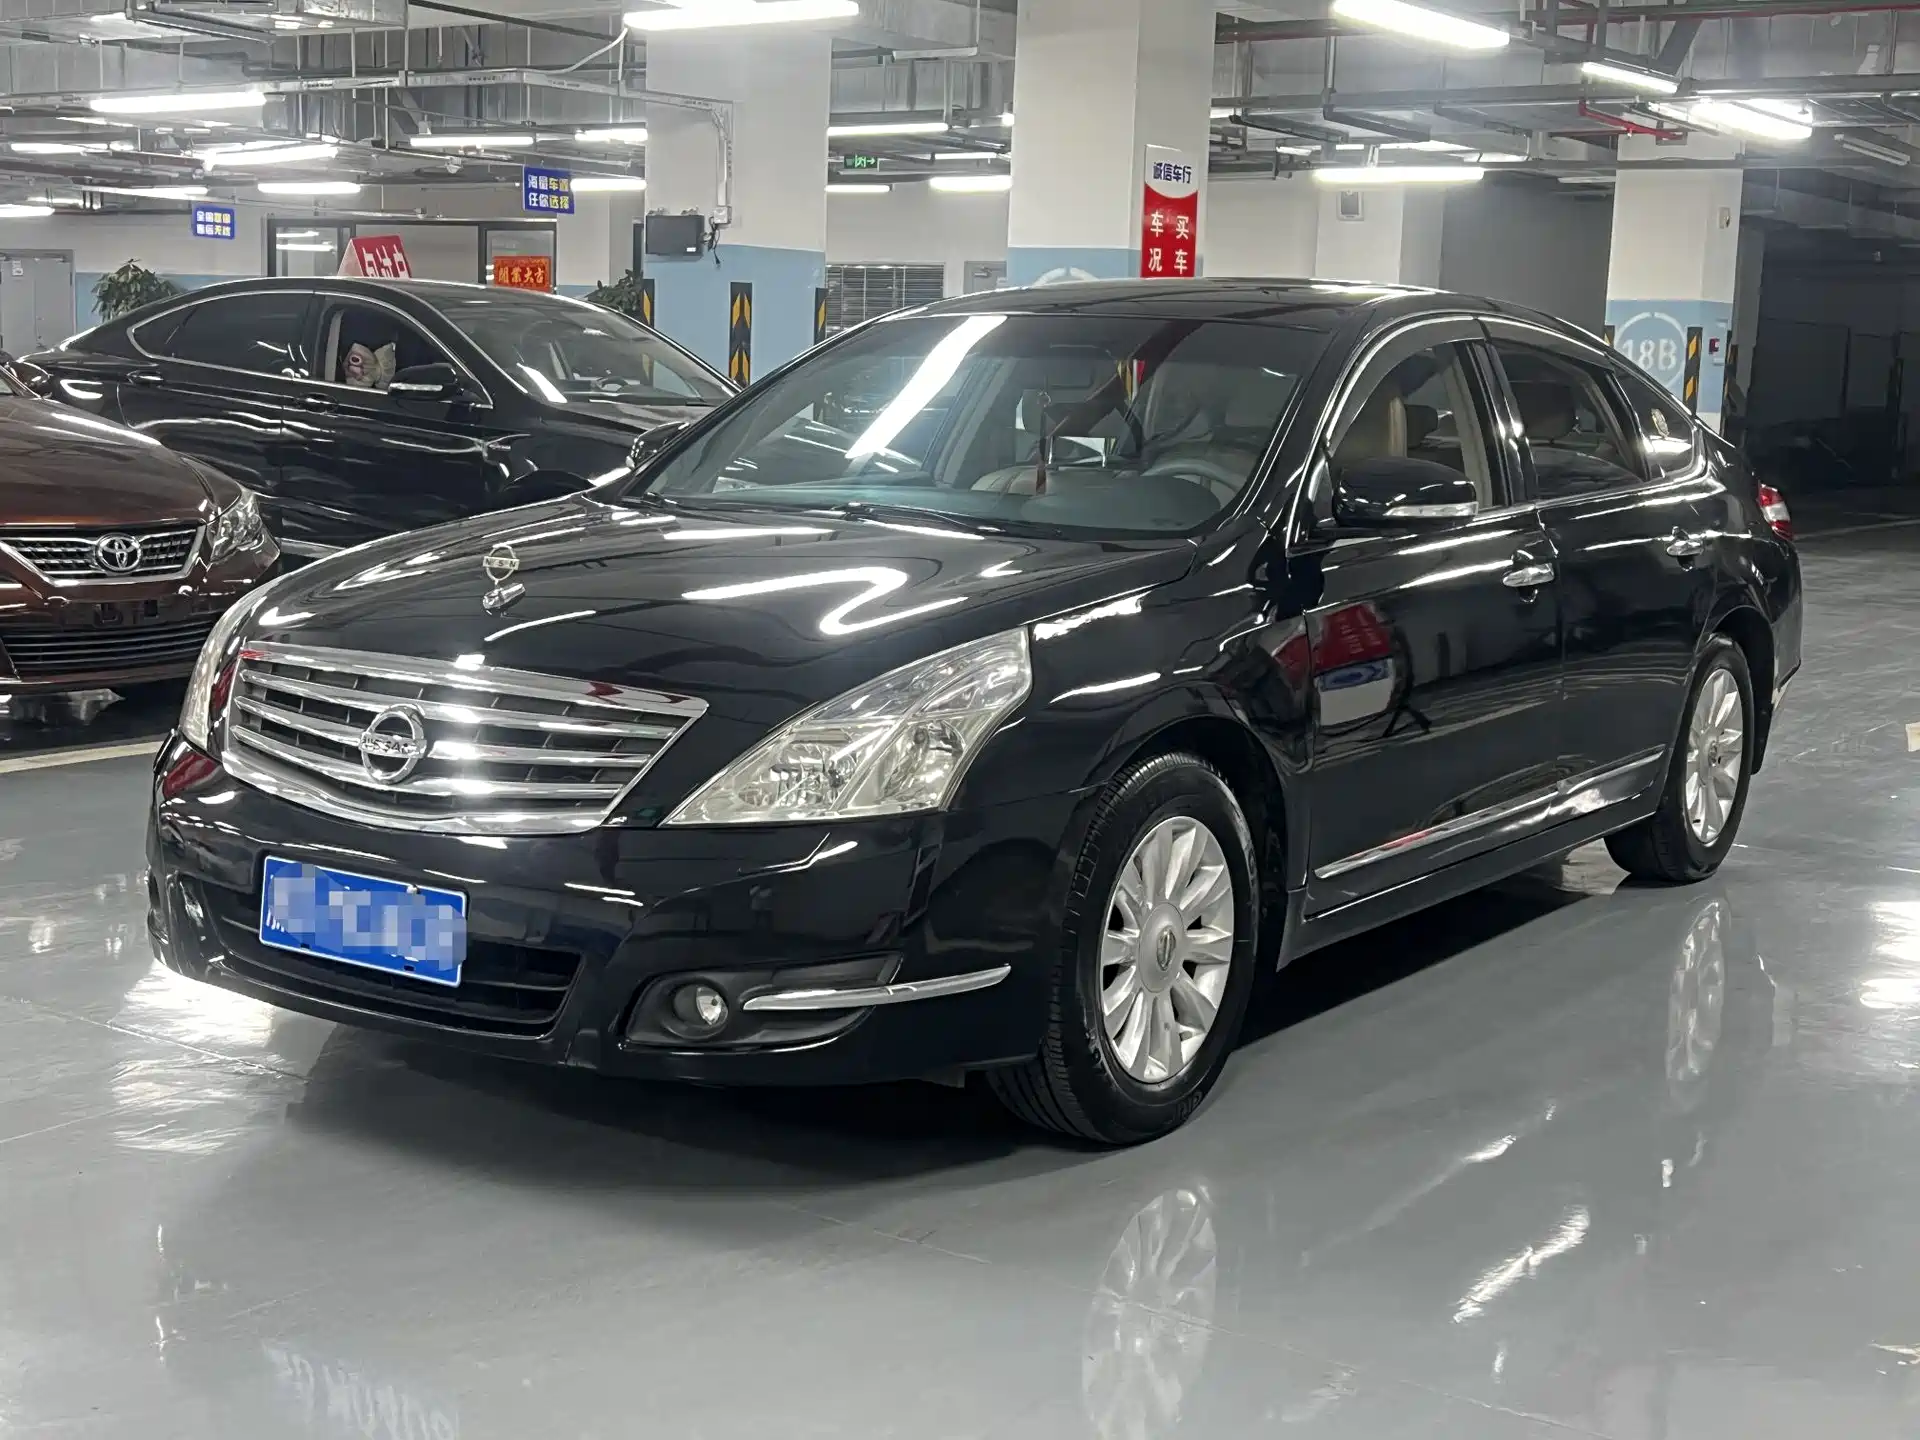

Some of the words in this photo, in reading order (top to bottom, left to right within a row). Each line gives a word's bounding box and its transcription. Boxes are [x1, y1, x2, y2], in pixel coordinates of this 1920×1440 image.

[1153, 161, 1191, 184] 诚信车行
[1148, 211, 1164, 273] 车况
[1174, 215, 1190, 275] 买车
[1622, 338, 1678, 371] 18B
